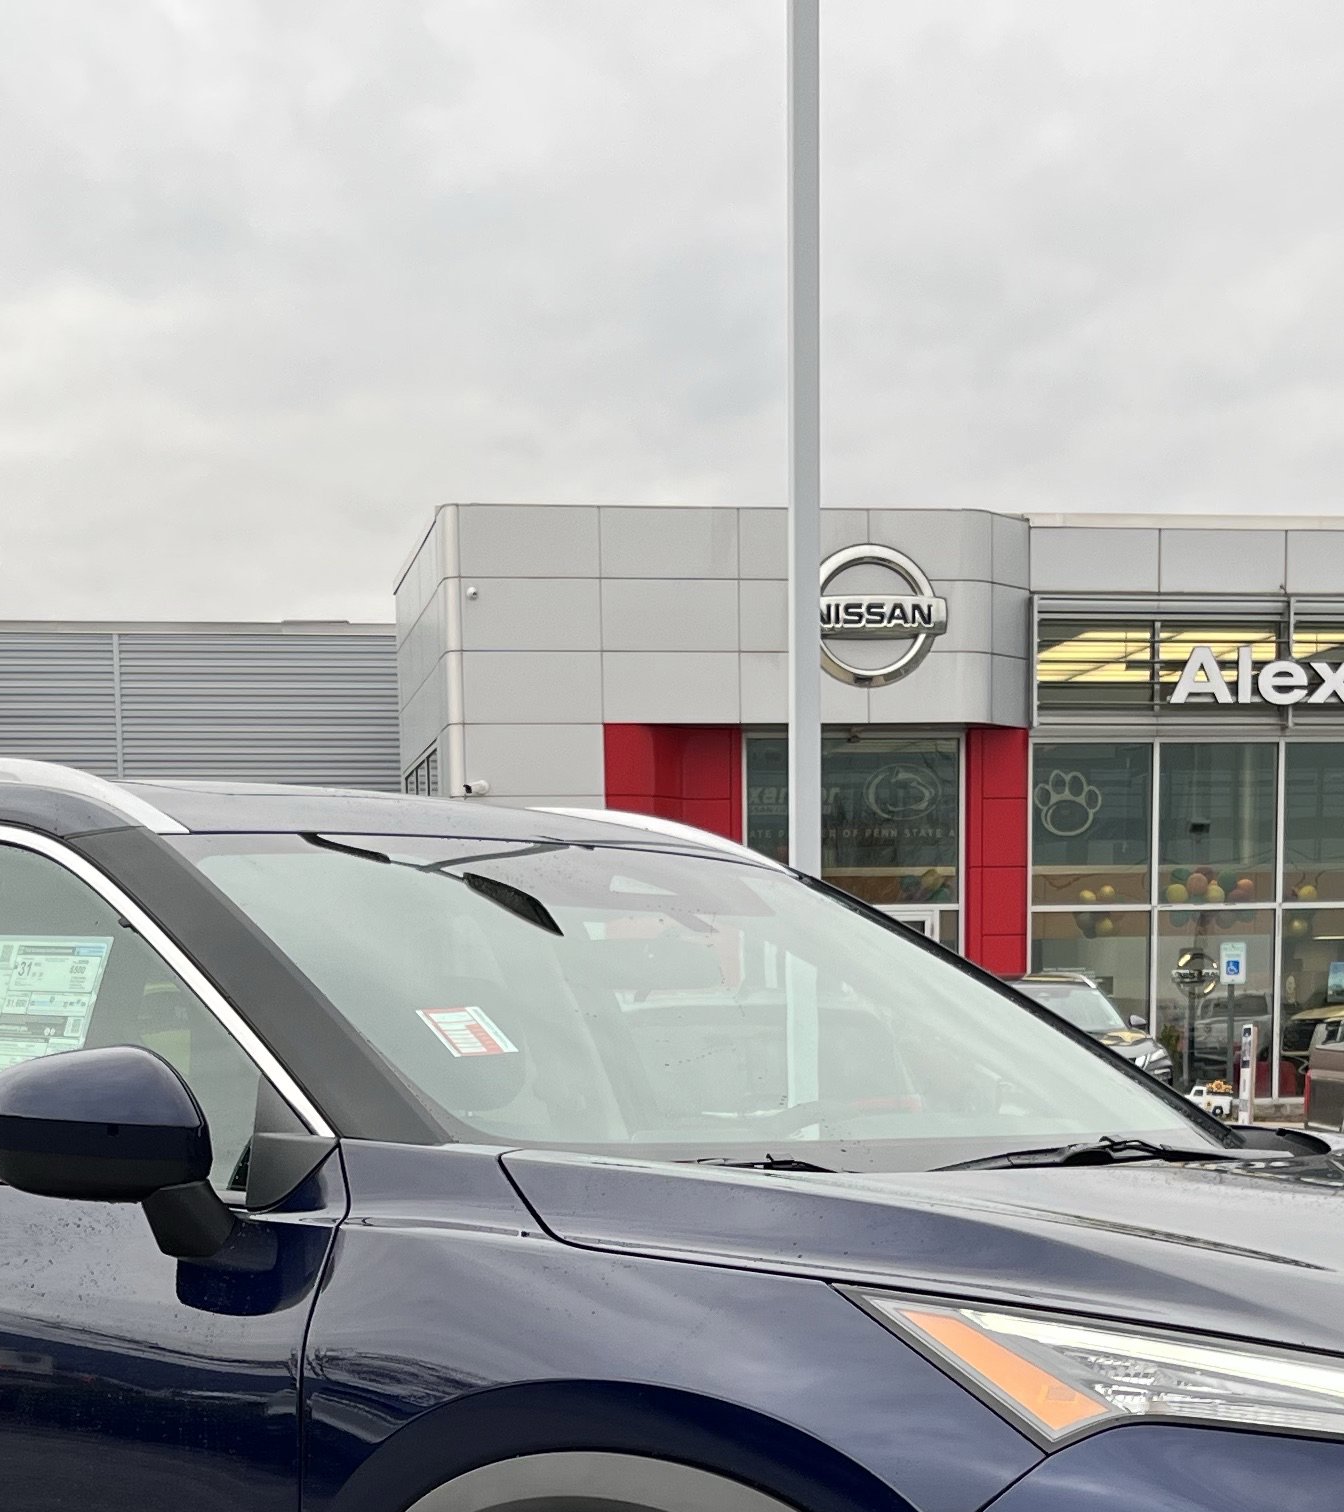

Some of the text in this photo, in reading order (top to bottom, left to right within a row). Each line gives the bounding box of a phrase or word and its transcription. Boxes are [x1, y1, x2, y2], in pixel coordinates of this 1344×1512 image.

[820, 603, 933, 625] NISSAN
[864, 828, 898, 838] PENN
[904, 828, 942, 838] STATE
